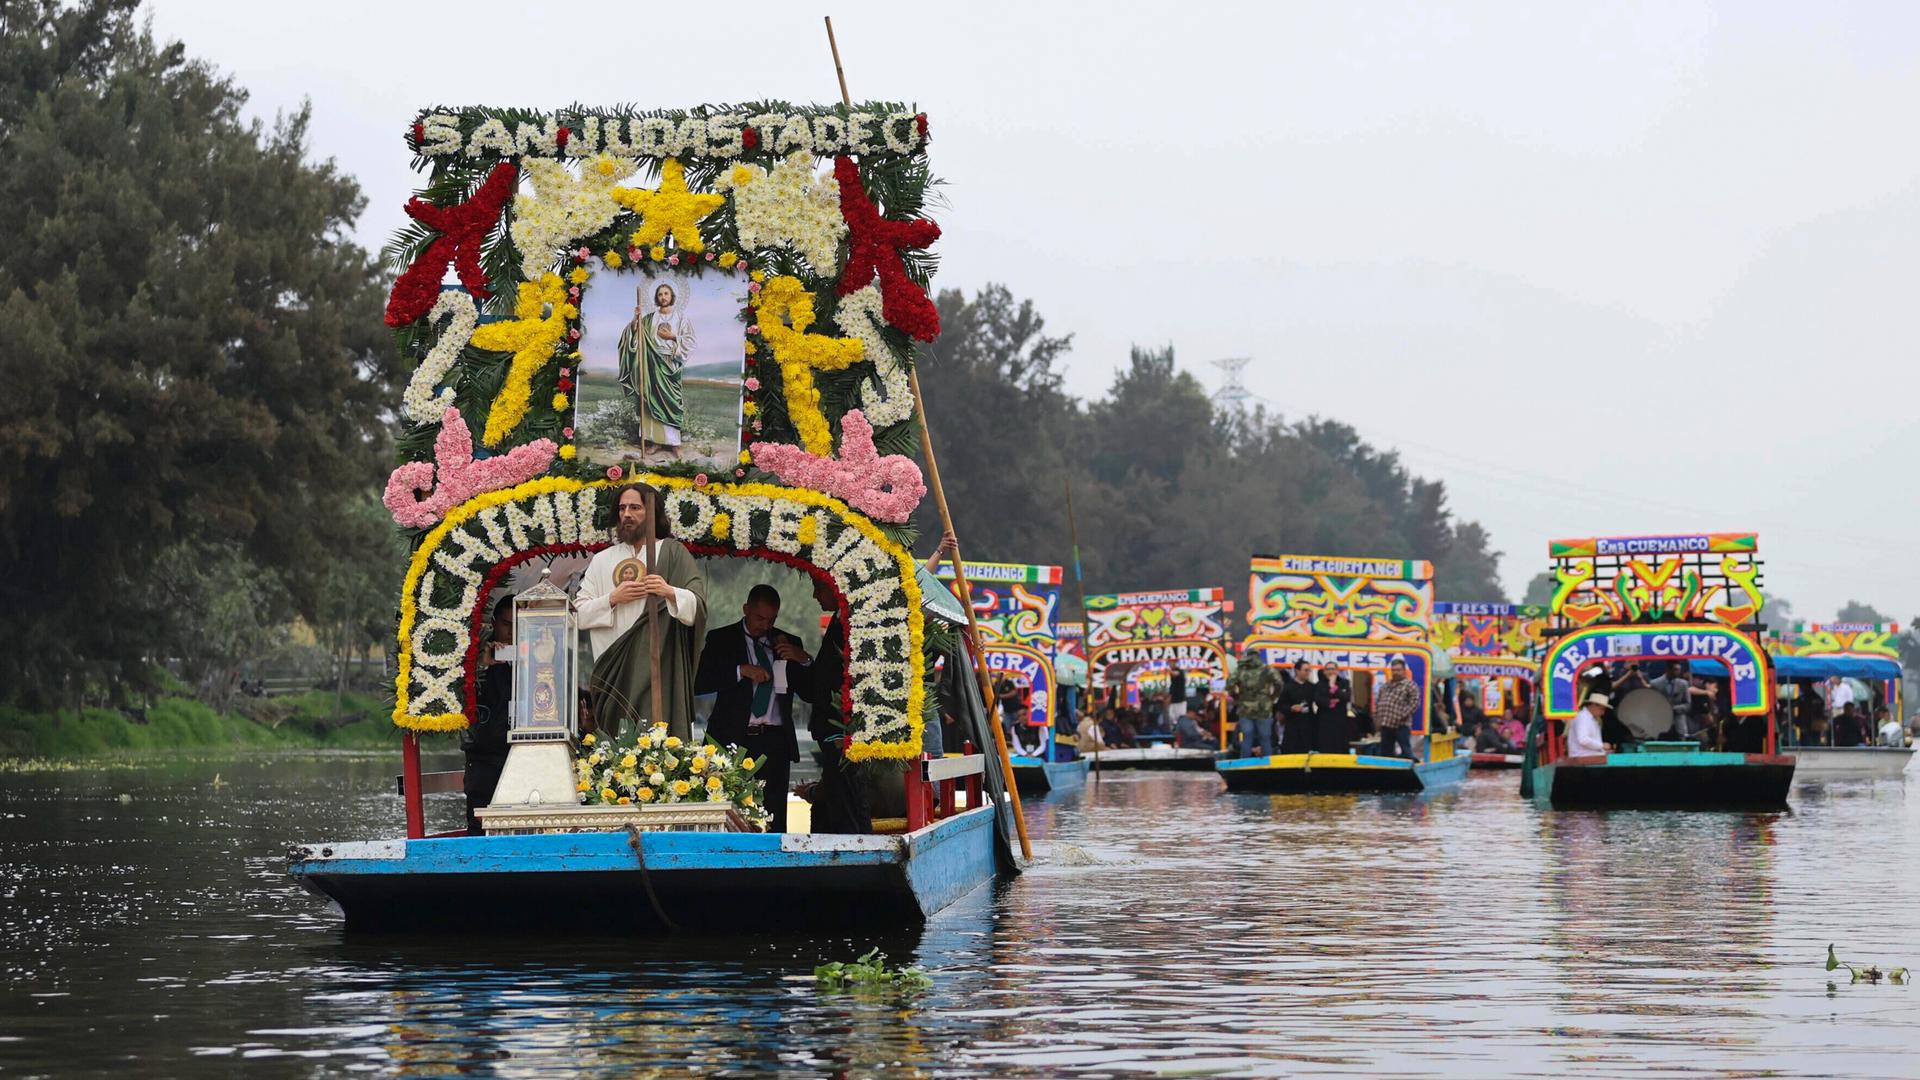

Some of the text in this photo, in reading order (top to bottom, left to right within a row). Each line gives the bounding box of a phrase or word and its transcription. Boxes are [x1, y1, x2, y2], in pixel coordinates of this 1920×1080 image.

[419, 111, 920, 159] SAN JUDAS TADEO
[1627, 537, 1709, 553] CUEMANCO
[1326, 562, 1401, 576] CUEMANCO
[408, 486, 716, 717] XOCHIMILO
[718, 494, 809, 556] TE
[1452, 603, 1489, 617] ERES
[1106, 646, 1224, 681] CHAPARRITA
[1266, 648, 1409, 669] PRINCESA
[1553, 635, 1755, 683] FELI CUMPLE
